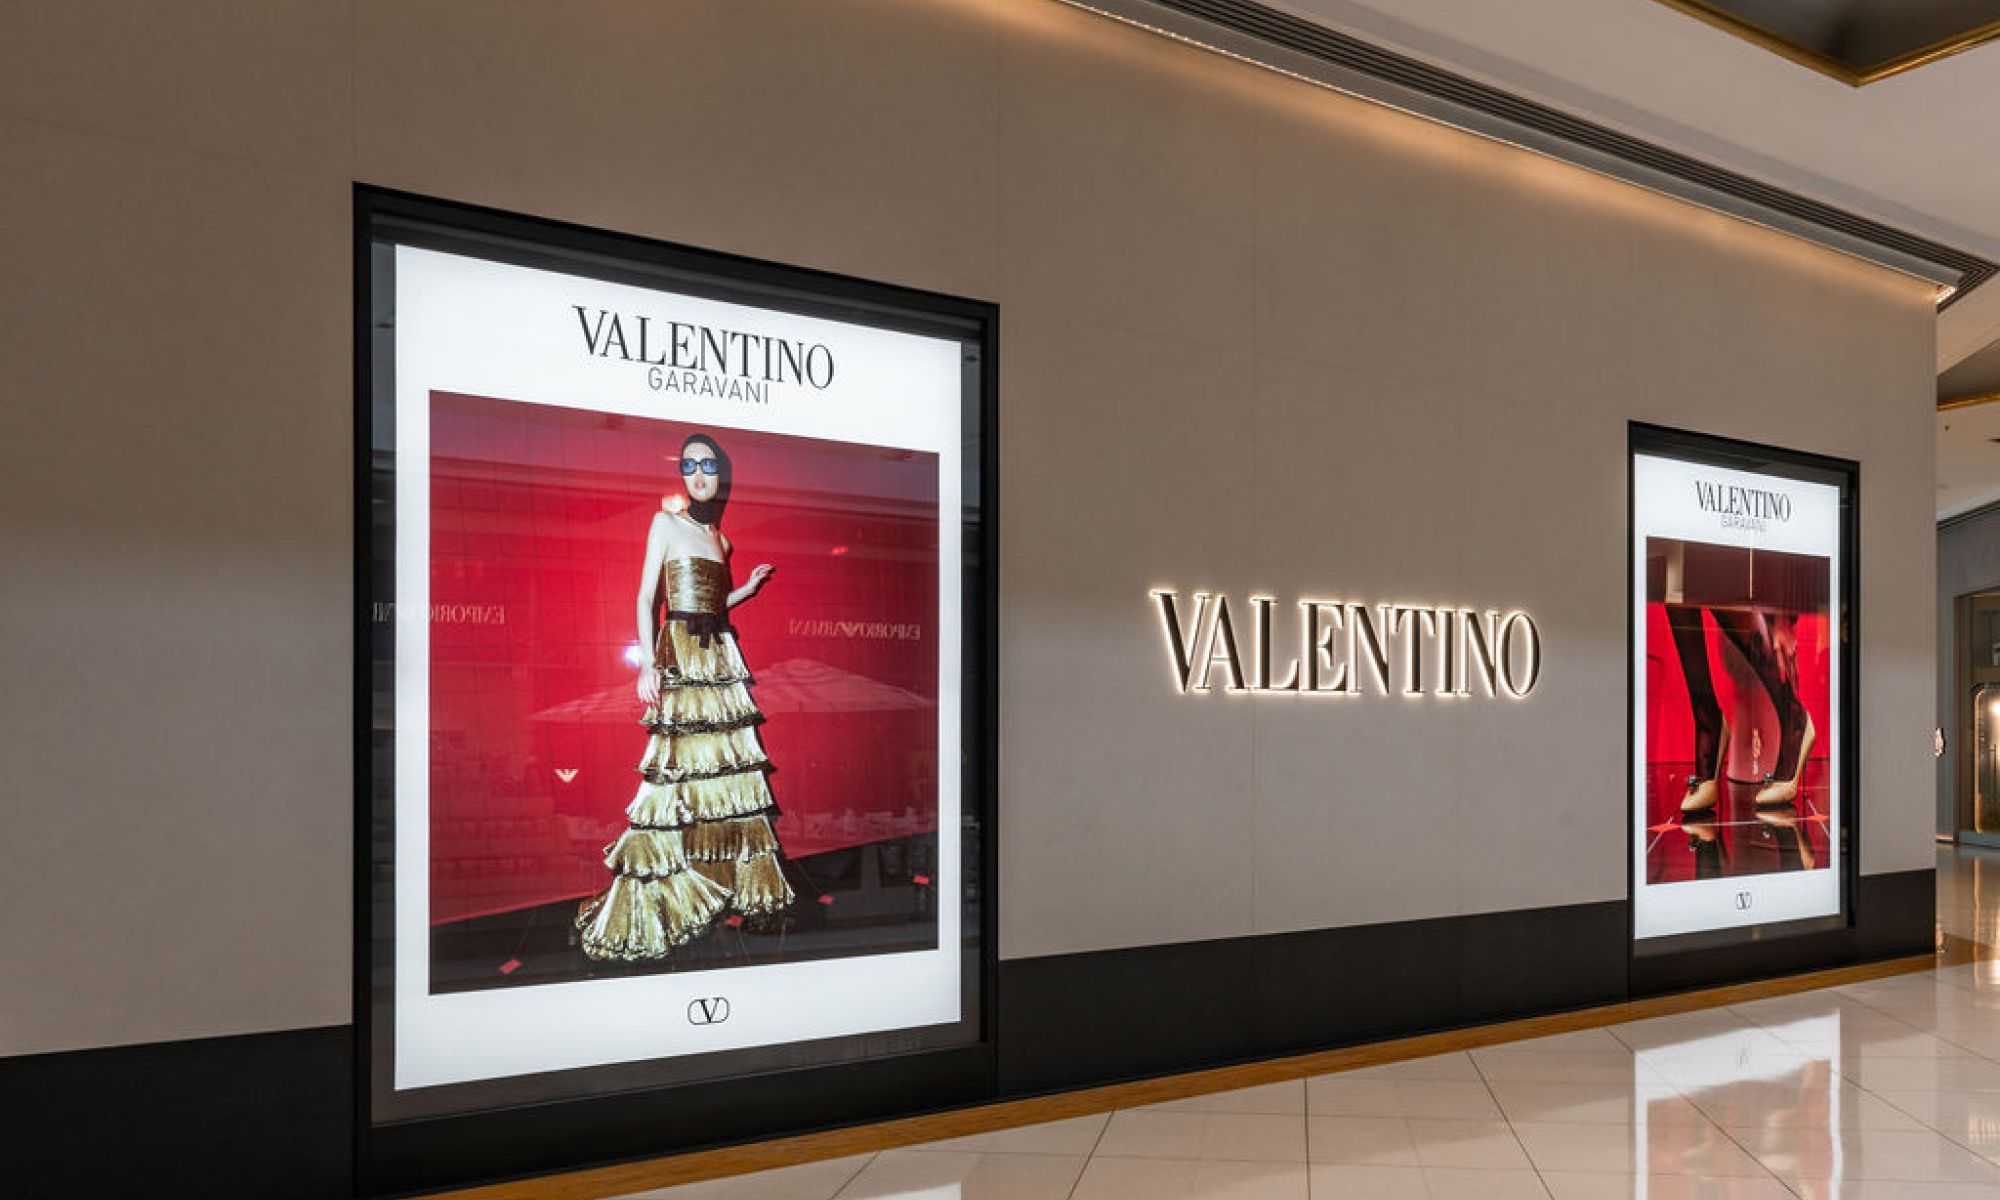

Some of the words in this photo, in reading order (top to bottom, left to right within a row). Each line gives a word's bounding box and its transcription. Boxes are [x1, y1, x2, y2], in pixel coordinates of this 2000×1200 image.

[572, 305, 834, 390] VALENTINO
[648, 367, 769, 405] GARAVANI
[1695, 480, 1791, 523] VALENTINO
[1149, 588, 1542, 699] VALENTINO
